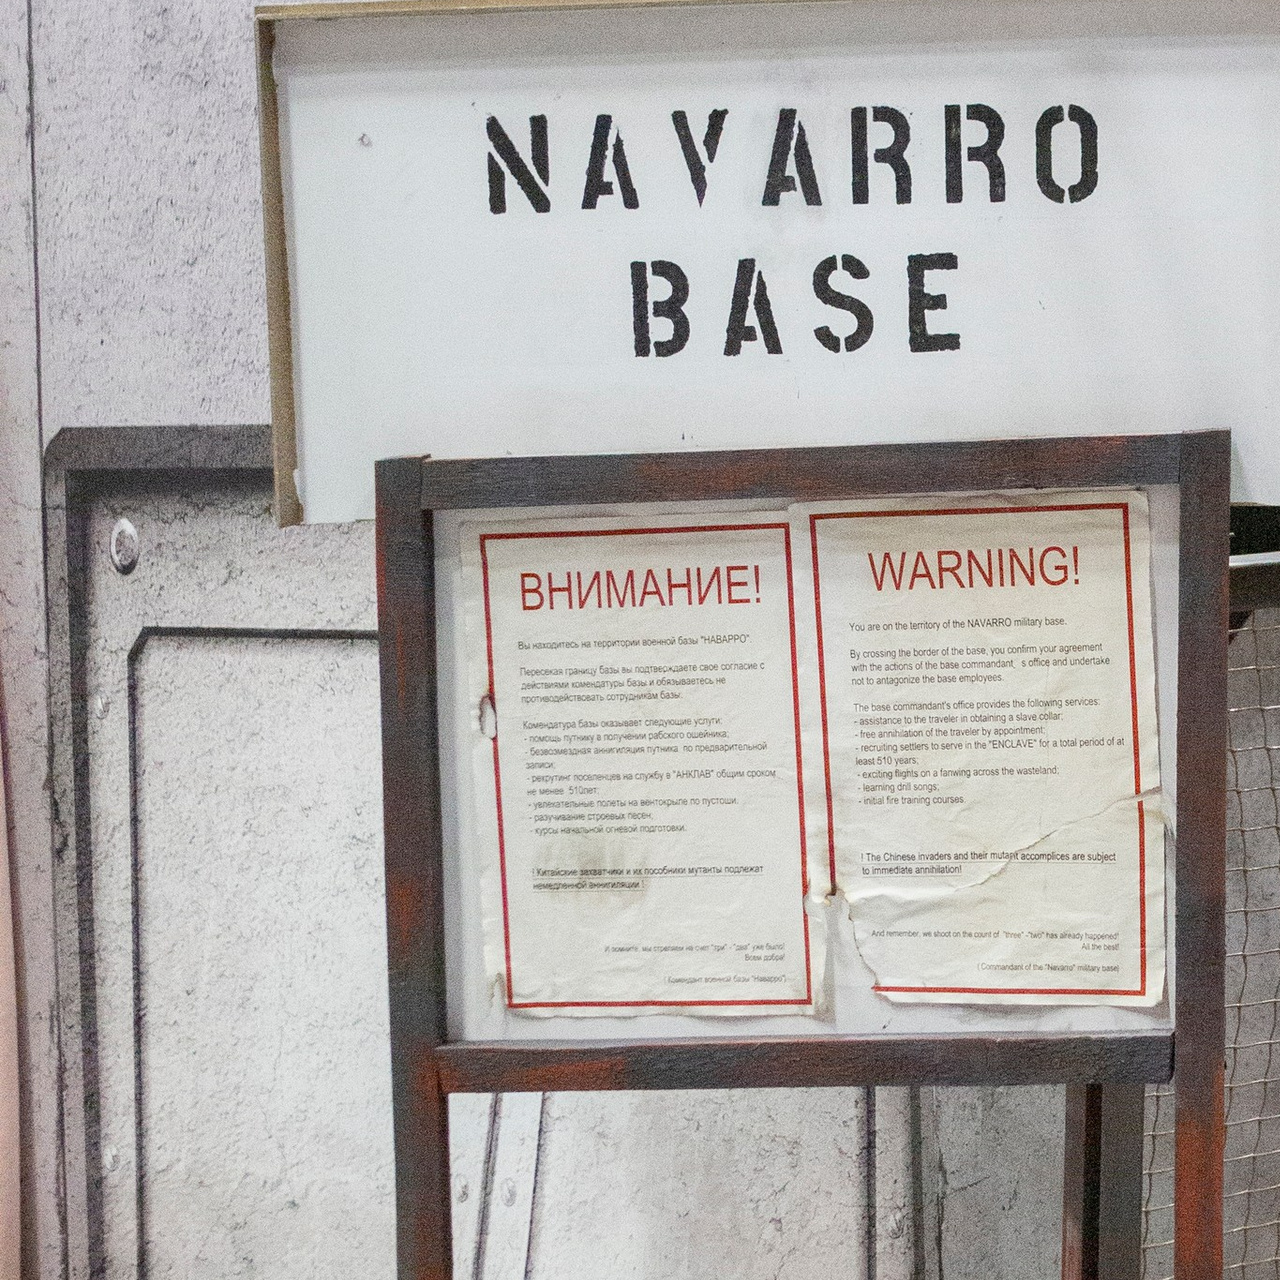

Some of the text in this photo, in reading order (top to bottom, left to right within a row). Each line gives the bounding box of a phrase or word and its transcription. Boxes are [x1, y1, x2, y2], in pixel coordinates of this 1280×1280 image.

[485, 103, 1099, 214] NAVARRO
[632, 252, 962, 358] BASE
[868, 546, 1079, 591] WARNING!
[520, 565, 761, 611] ВНИМАНИЕ!
[848, 622, 865, 631] You
[894, 620, 908, 629] the
[909, 619, 940, 631] territory
[941, 619, 950, 628] of
[952, 619, 965, 627] the
[967, 617, 1012, 627] NAVARRO
[1013, 616, 1042, 628] military
[849, 649, 860, 660] By
[862, 648, 896, 659] crossing
[897, 647, 911, 656] the
[912, 647, 939, 656] border
[940, 646, 949, 655] of
[950, 646, 964, 655] the
[989, 647, 1005, 656] you
[1006, 643, 1037, 653] confirm
[1039, 645, 1056, 654] your
[1058, 642, 1102, 654] agreement
[850, 662, 867, 671] with
[869, 662, 882, 670] the
[883, 661, 913, 670] actions
[914, 660, 923, 669] of
[924, 660, 938, 669] the
[939, 659, 959, 668] base
[1027, 657, 1050, 666] office
[1051, 656, 1067, 665] and
[1069, 655, 1110, 665] undertake
[851, 676, 864, 684] not
[865, 676, 874, 684] to
[875, 674, 920, 686] antagonize
[921, 674, 935, 682] the
[936, 673, 956, 682] base
[853, 702, 869, 711] The
[870, 701, 891, 710] base
[952, 699, 974, 708] office
[975, 698, 1010, 710] provides
[1012, 698, 1025, 707] the
[1027, 697, 1063, 708] following
[858, 715, 902, 724] assistance
[903, 715, 912, 723] to
[913, 714, 926, 723] the
[928, 713, 958, 722] traveler
[959, 713, 968, 722] in
[969, 712, 1006, 724] obtaining
[1015, 711, 1037, 720] slave
[859, 729, 876, 737] free
[877, 727, 923, 737] annihilation
[924, 727, 933, 736] of
[934, 727, 948, 735] the
[949, 726, 979, 735] traveler
[981, 726, 991, 737] by
[860, 742, 898, 753] recruiting
[899, 741, 929, 750] settlers
[930, 741, 939, 749] to
[964, 740, 972, 748] in
[973, 739, 986, 748] the
[1038, 738, 1050, 747] for
[1059, 737, 1077, 746] total
[1078, 737, 1104, 748] period
[1106, 736, 1114, 745] of
[1116, 737, 1124, 745] at
[855, 756, 875, 764] least
[876, 756, 892, 764] 510
[861, 768, 893, 779] exciting
[894, 768, 918, 779] flights
[939, 767, 971, 778] fanwing
[1001, 766, 1014, 775] the
[862, 782, 895, 792] learning
[896, 782, 911, 790] drill
[863, 795, 884, 803] initial
[886, 795, 899, 803] fire
[900, 794, 930, 805] training
[865, 852, 881, 861] The
[882, 852, 916, 861] Chinese
[917, 852, 951, 860] invaders
[953, 852, 968, 860] and
[970, 852, 987, 860] their
[989, 852, 1018, 860] mutant
[1020, 851, 1070, 862] accomplices
[1087, 851, 1116, 862] subject
[871, 865, 913, 874] immediate
